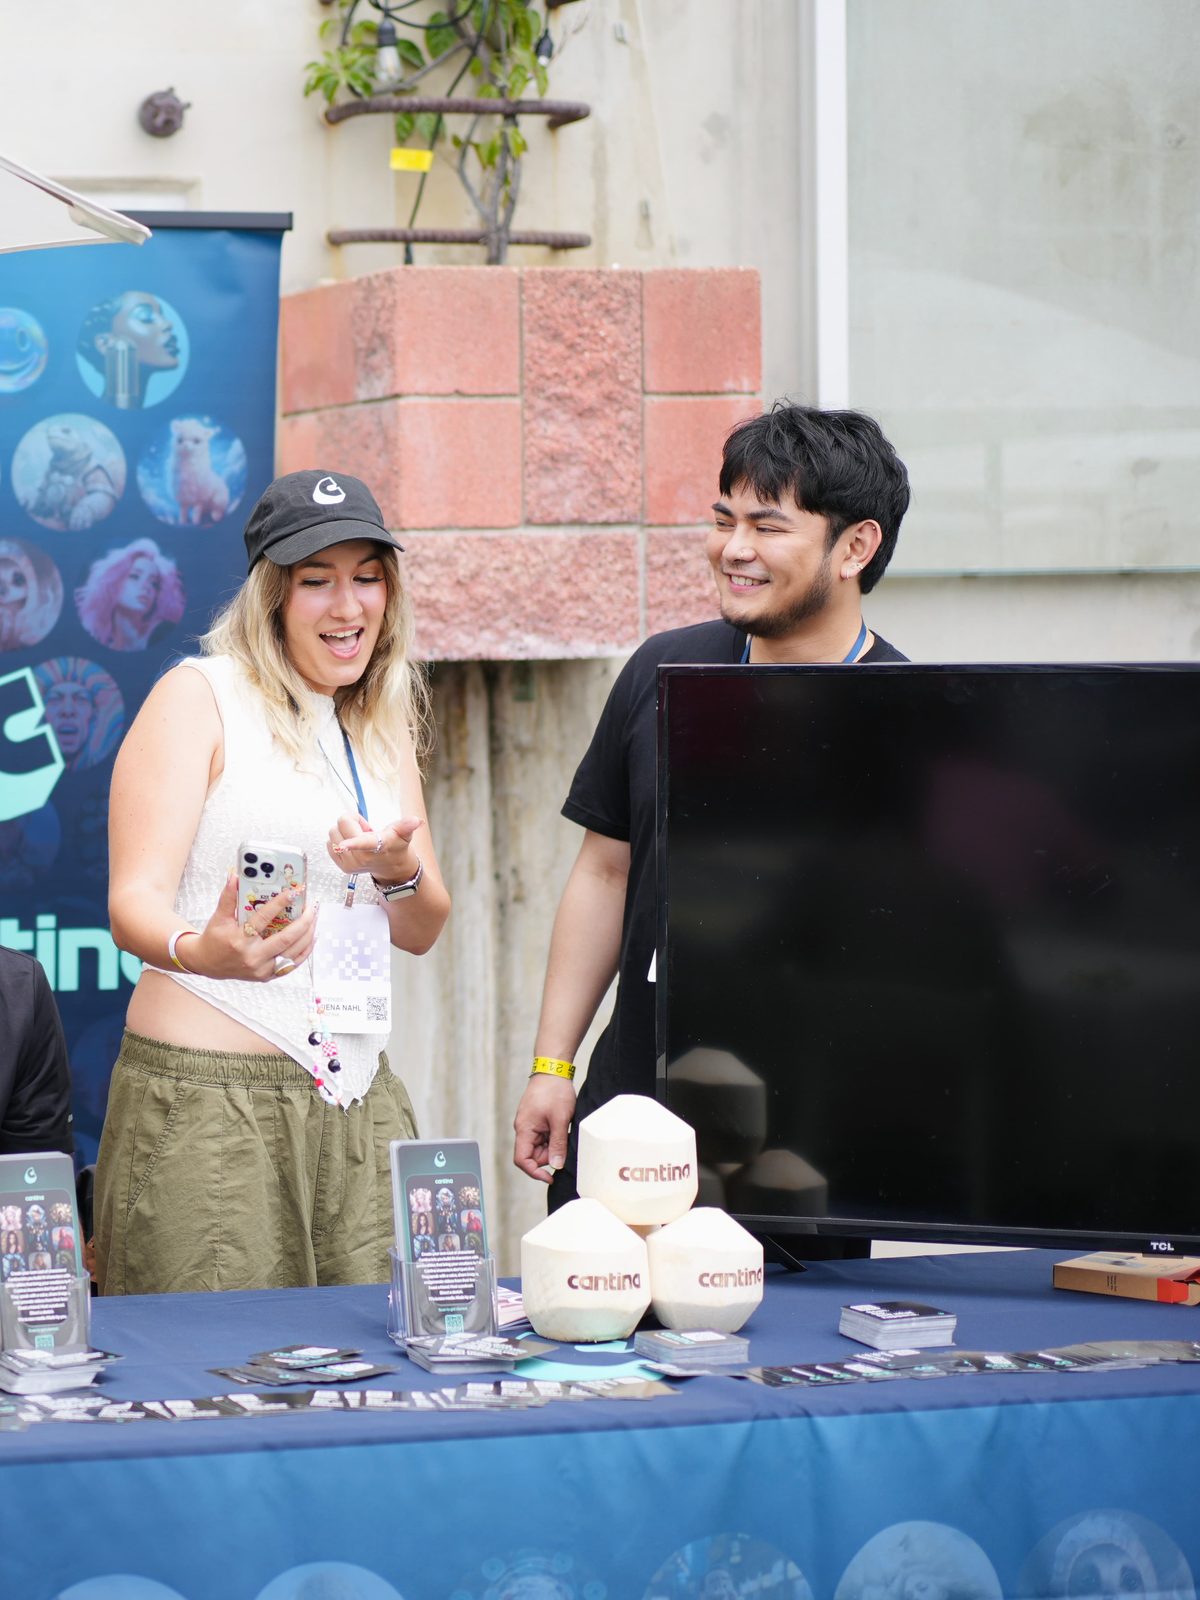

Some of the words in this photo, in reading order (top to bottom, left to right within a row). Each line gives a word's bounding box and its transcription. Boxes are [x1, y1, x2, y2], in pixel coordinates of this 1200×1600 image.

[342, 1004, 362, 1012] NAHL
[618, 1163, 690, 1182] cantina
[1150, 1241, 1175, 1251] TCL
[567, 1272, 641, 1291] cantina
